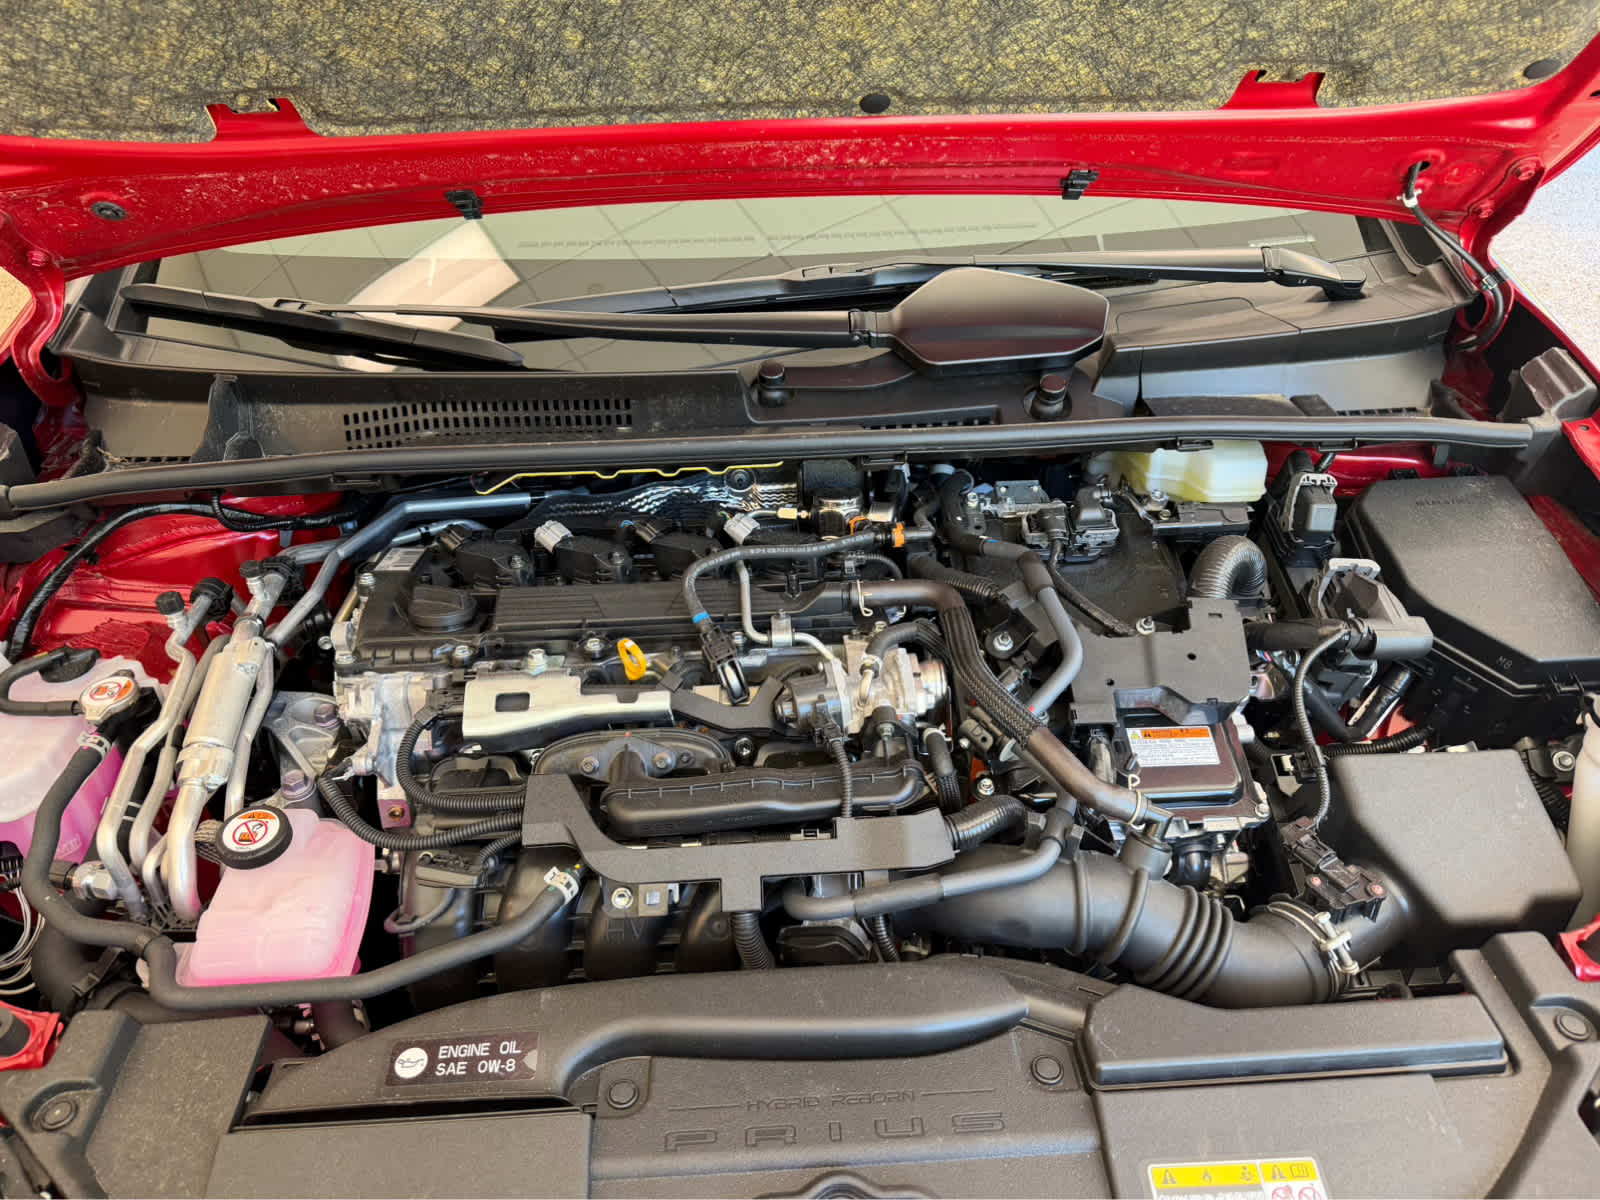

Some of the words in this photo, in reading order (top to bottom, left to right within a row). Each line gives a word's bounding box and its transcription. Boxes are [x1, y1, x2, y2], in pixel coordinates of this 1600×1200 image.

[438, 1042, 491, 1059] ENGINE
[499, 1040, 522, 1055] OIL
[435, 1061, 468, 1076] SAE
[477, 1058, 516, 1074] 0W-8
[746, 1095, 820, 1112] HYBRID
[664, 1112, 1006, 1152] PRIUS
